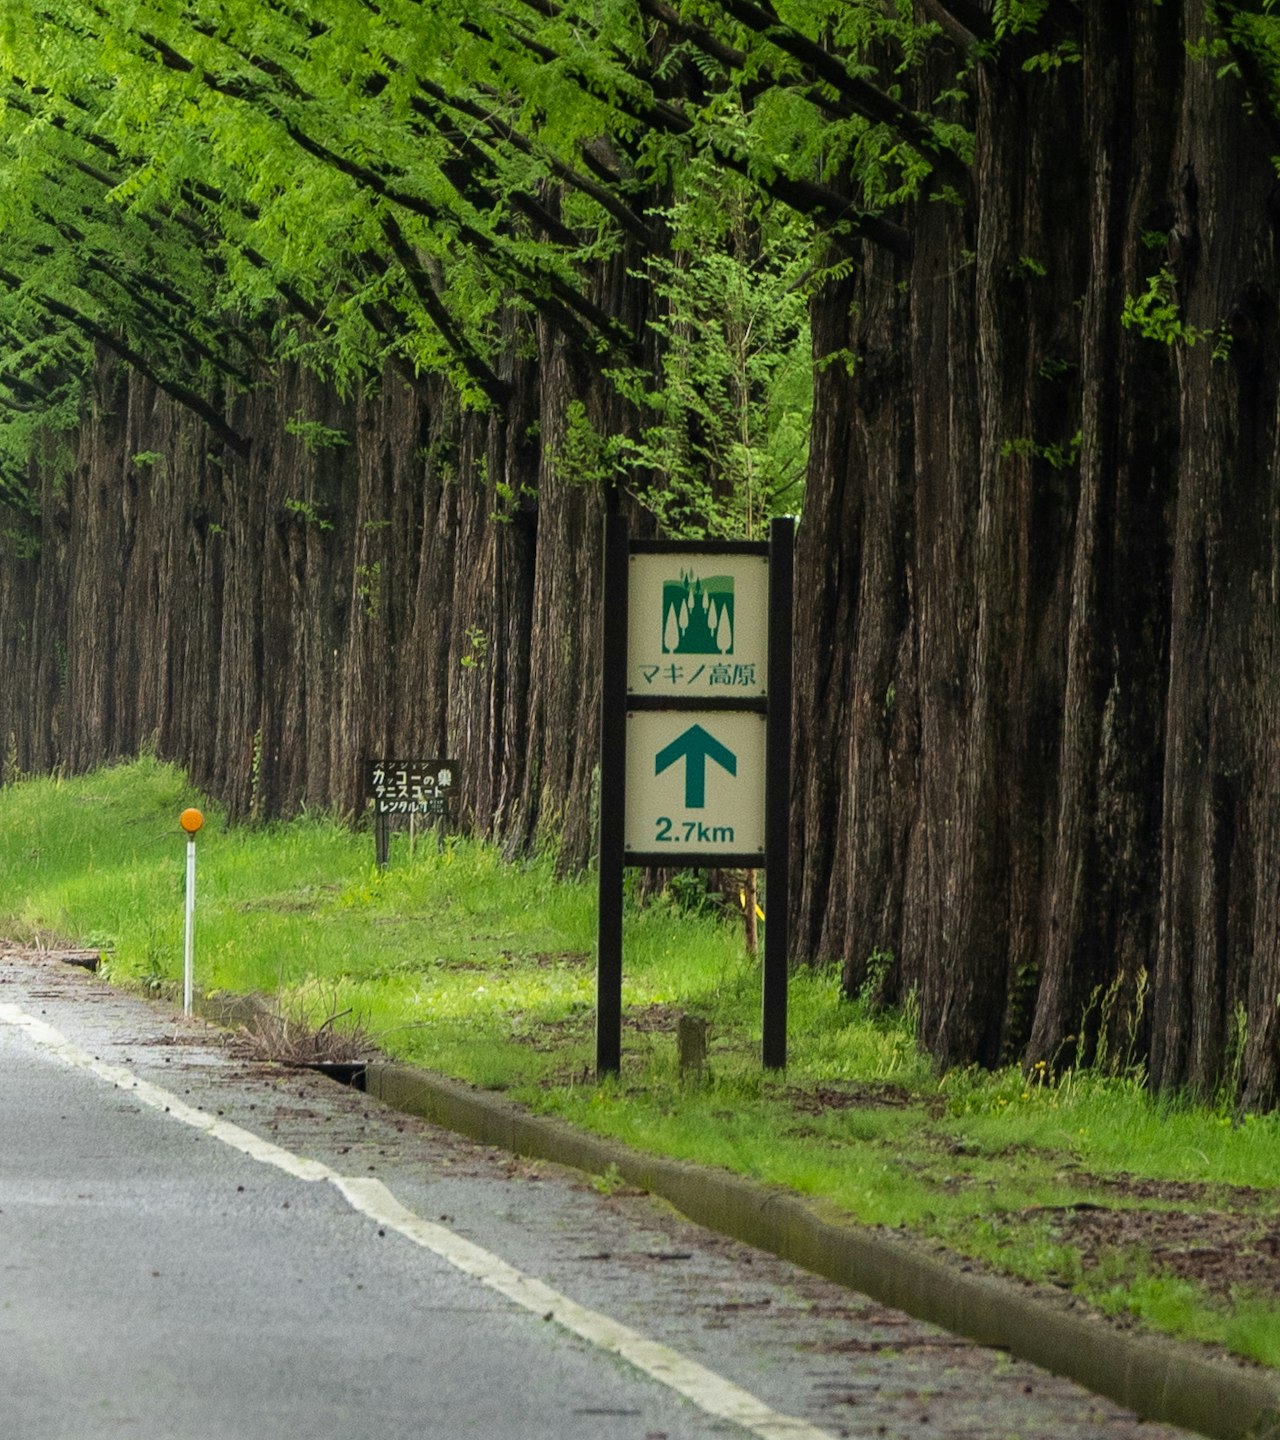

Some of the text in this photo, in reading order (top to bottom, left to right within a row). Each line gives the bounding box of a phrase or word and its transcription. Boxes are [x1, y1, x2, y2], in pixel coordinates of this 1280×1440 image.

[638, 662, 756, 686] マキノ高原
[655, 816, 734, 843] 2.7km
